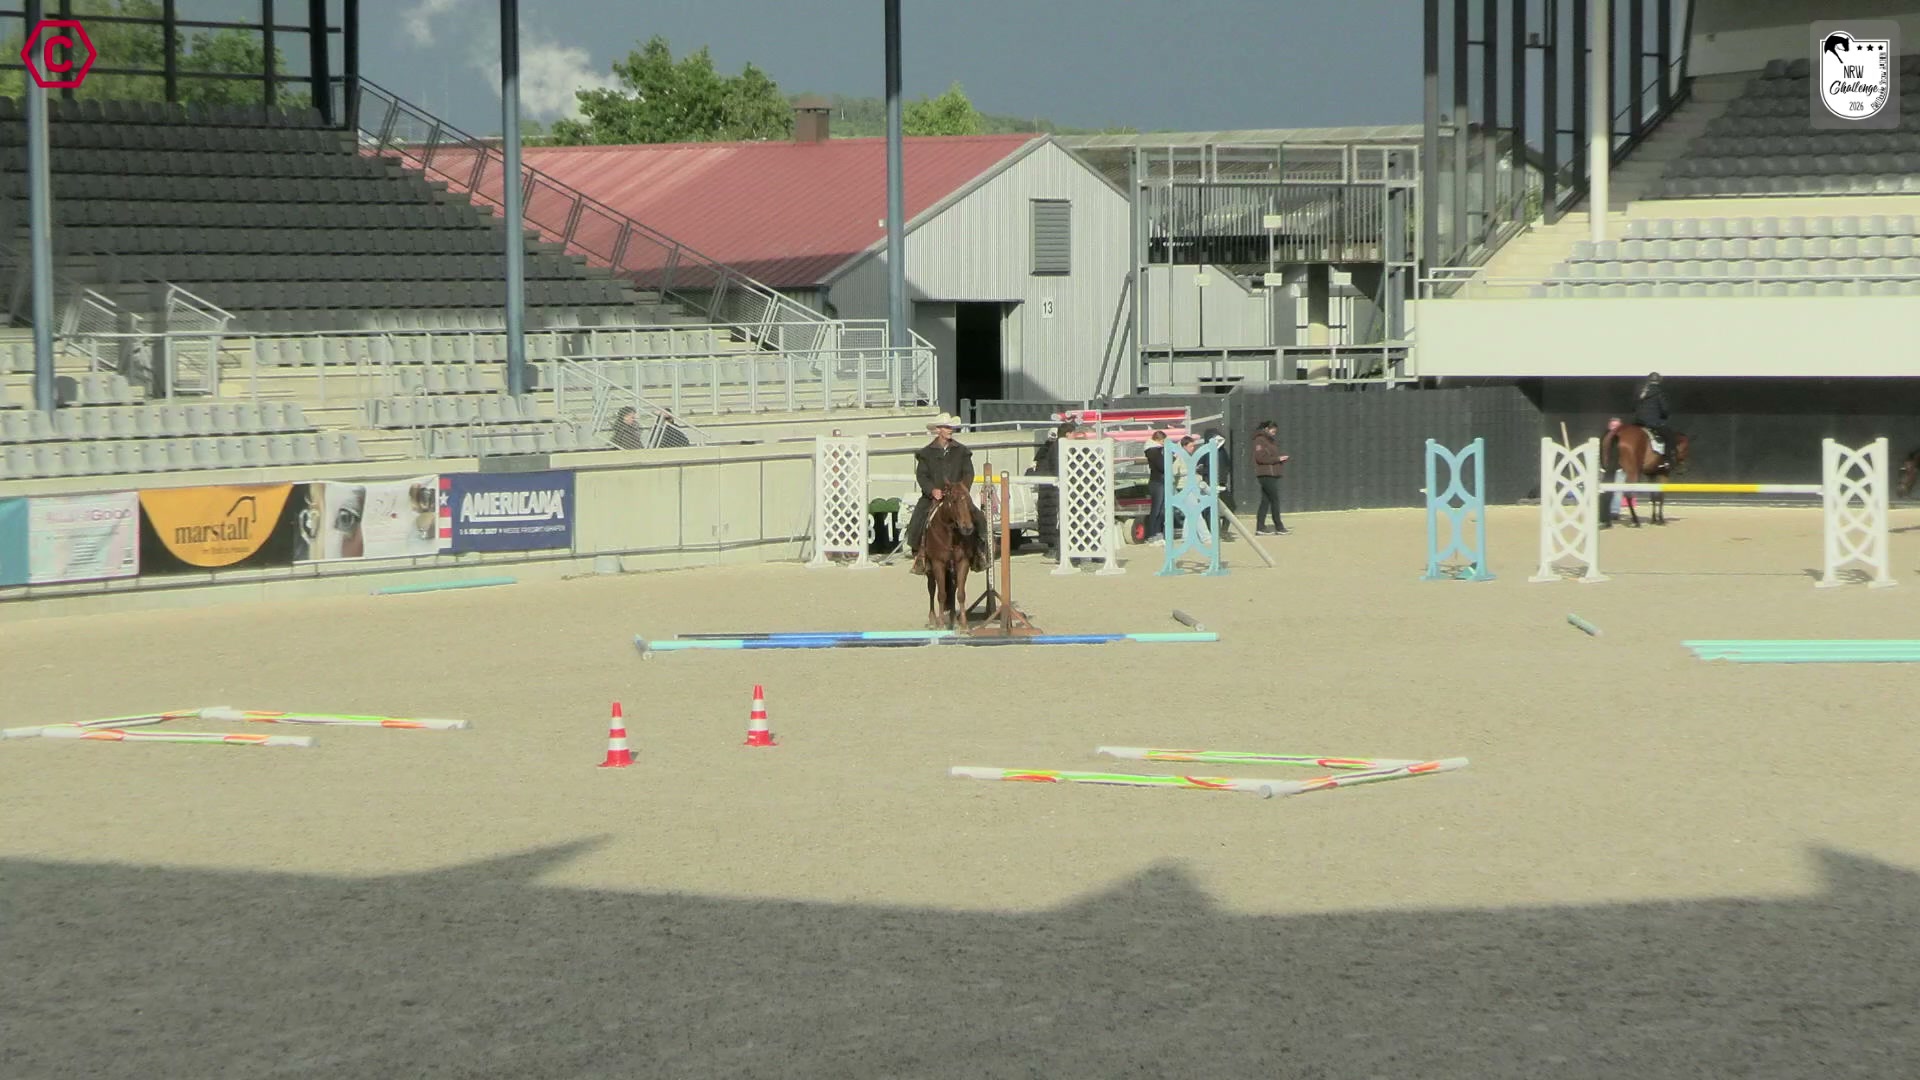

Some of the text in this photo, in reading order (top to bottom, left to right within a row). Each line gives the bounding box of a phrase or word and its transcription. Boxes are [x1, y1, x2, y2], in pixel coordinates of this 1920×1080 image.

[1043, 301, 1053, 314] 13
[460, 490, 564, 522] AMERICANA
[175, 517, 249, 544] marstall
